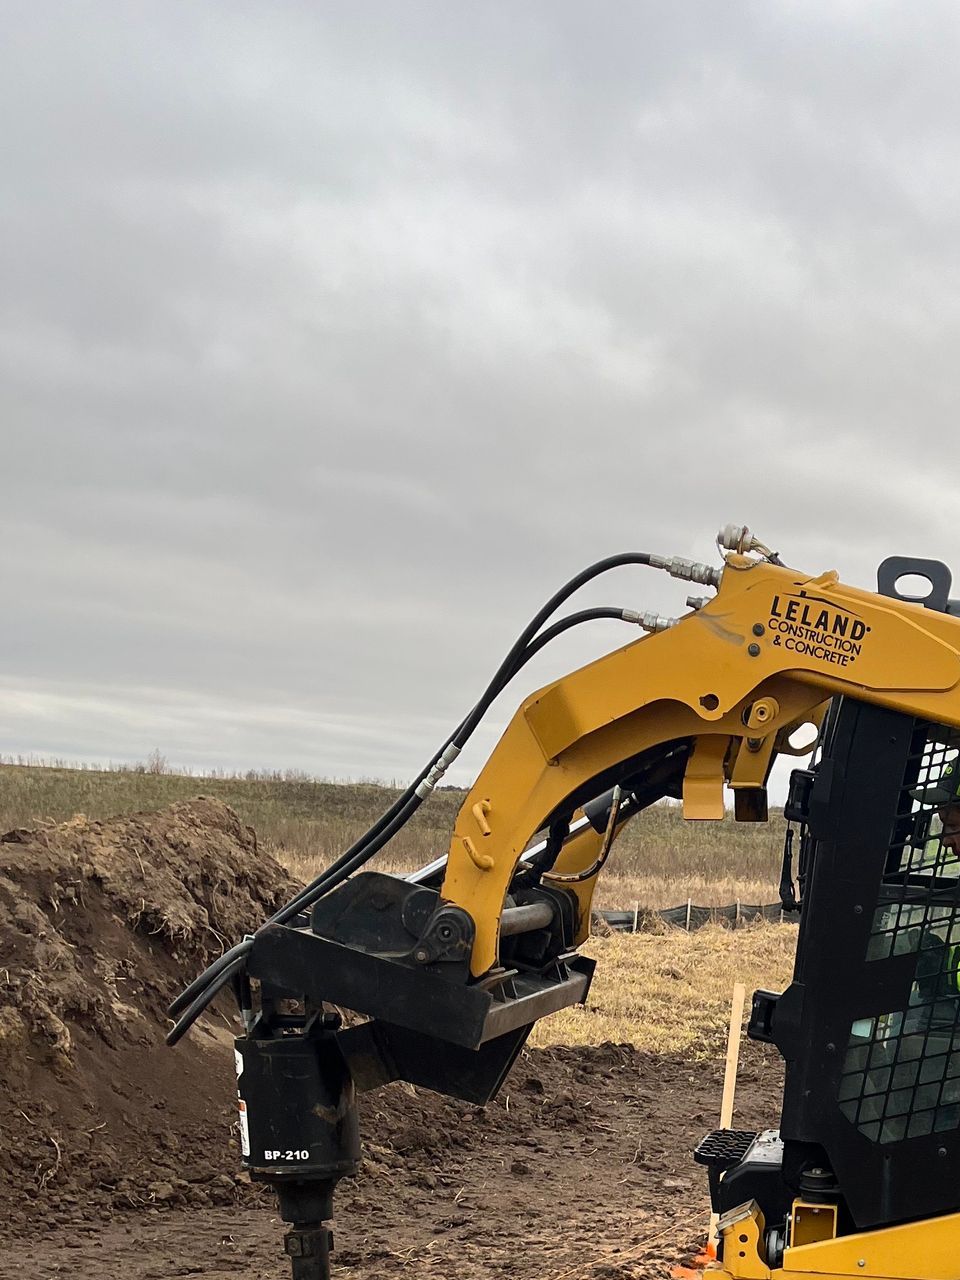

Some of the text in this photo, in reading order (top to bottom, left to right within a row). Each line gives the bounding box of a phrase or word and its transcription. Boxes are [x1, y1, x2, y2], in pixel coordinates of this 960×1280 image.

[771, 595, 866, 641] LELAND
[768, 618, 862, 655] CONSTRUCTION
[773, 634, 850, 667] & CONCRETE
[264, 1150, 310, 1160] BP-210
